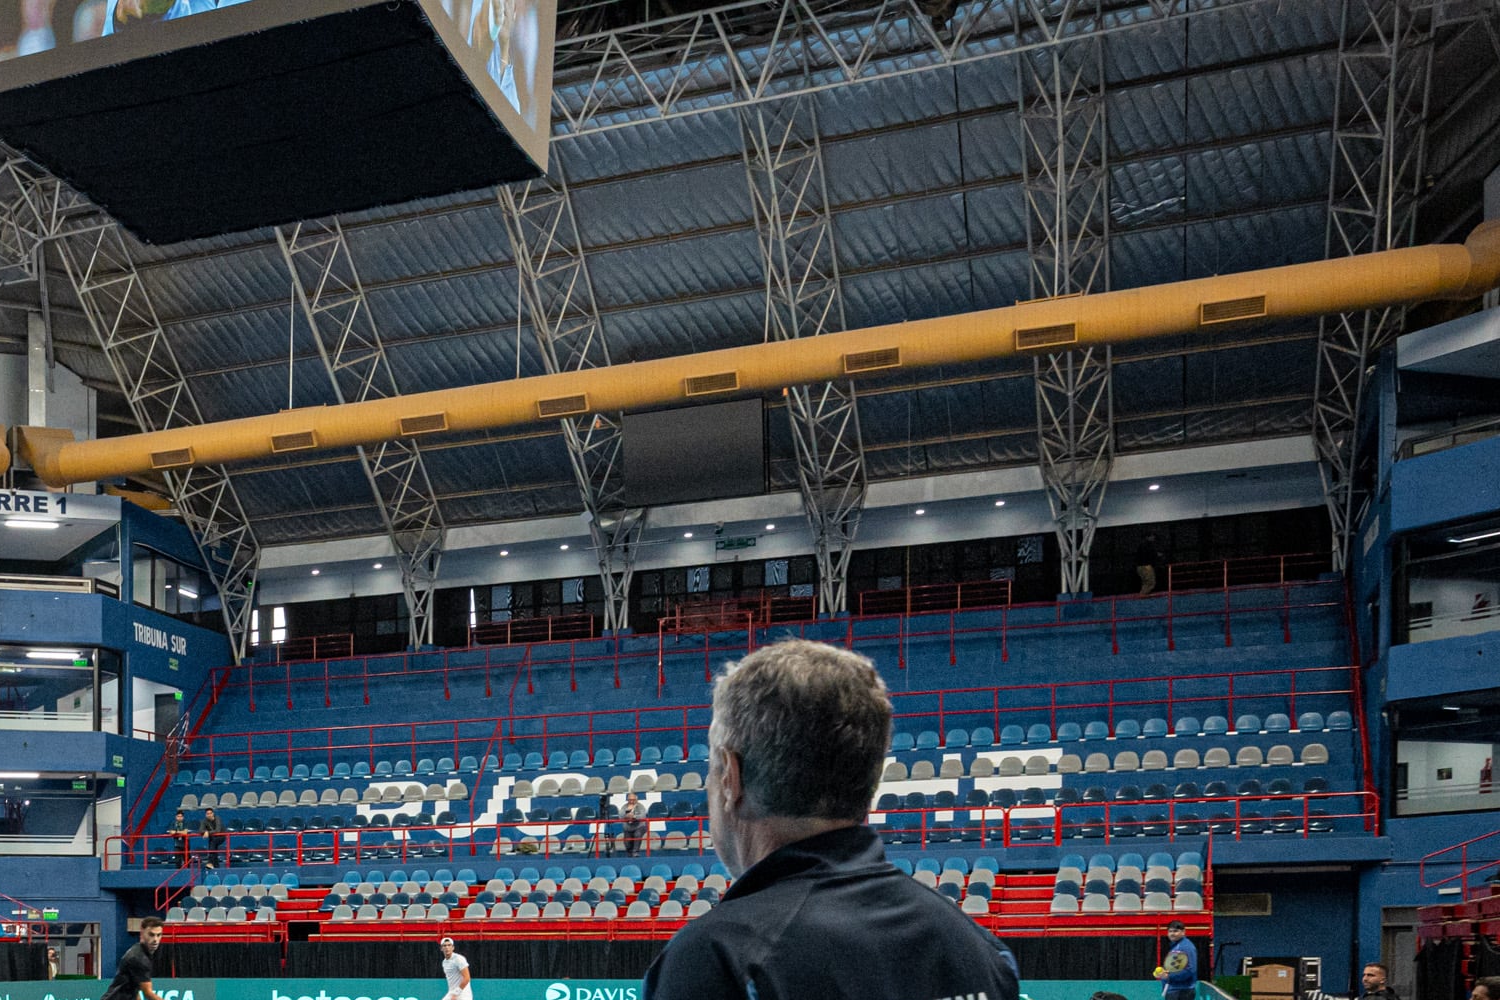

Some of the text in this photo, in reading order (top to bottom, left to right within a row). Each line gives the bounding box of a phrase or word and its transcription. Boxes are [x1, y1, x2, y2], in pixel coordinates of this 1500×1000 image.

[56, 496, 67, 515] 1
[132, 621, 187, 656] TRIBUNA SUR
